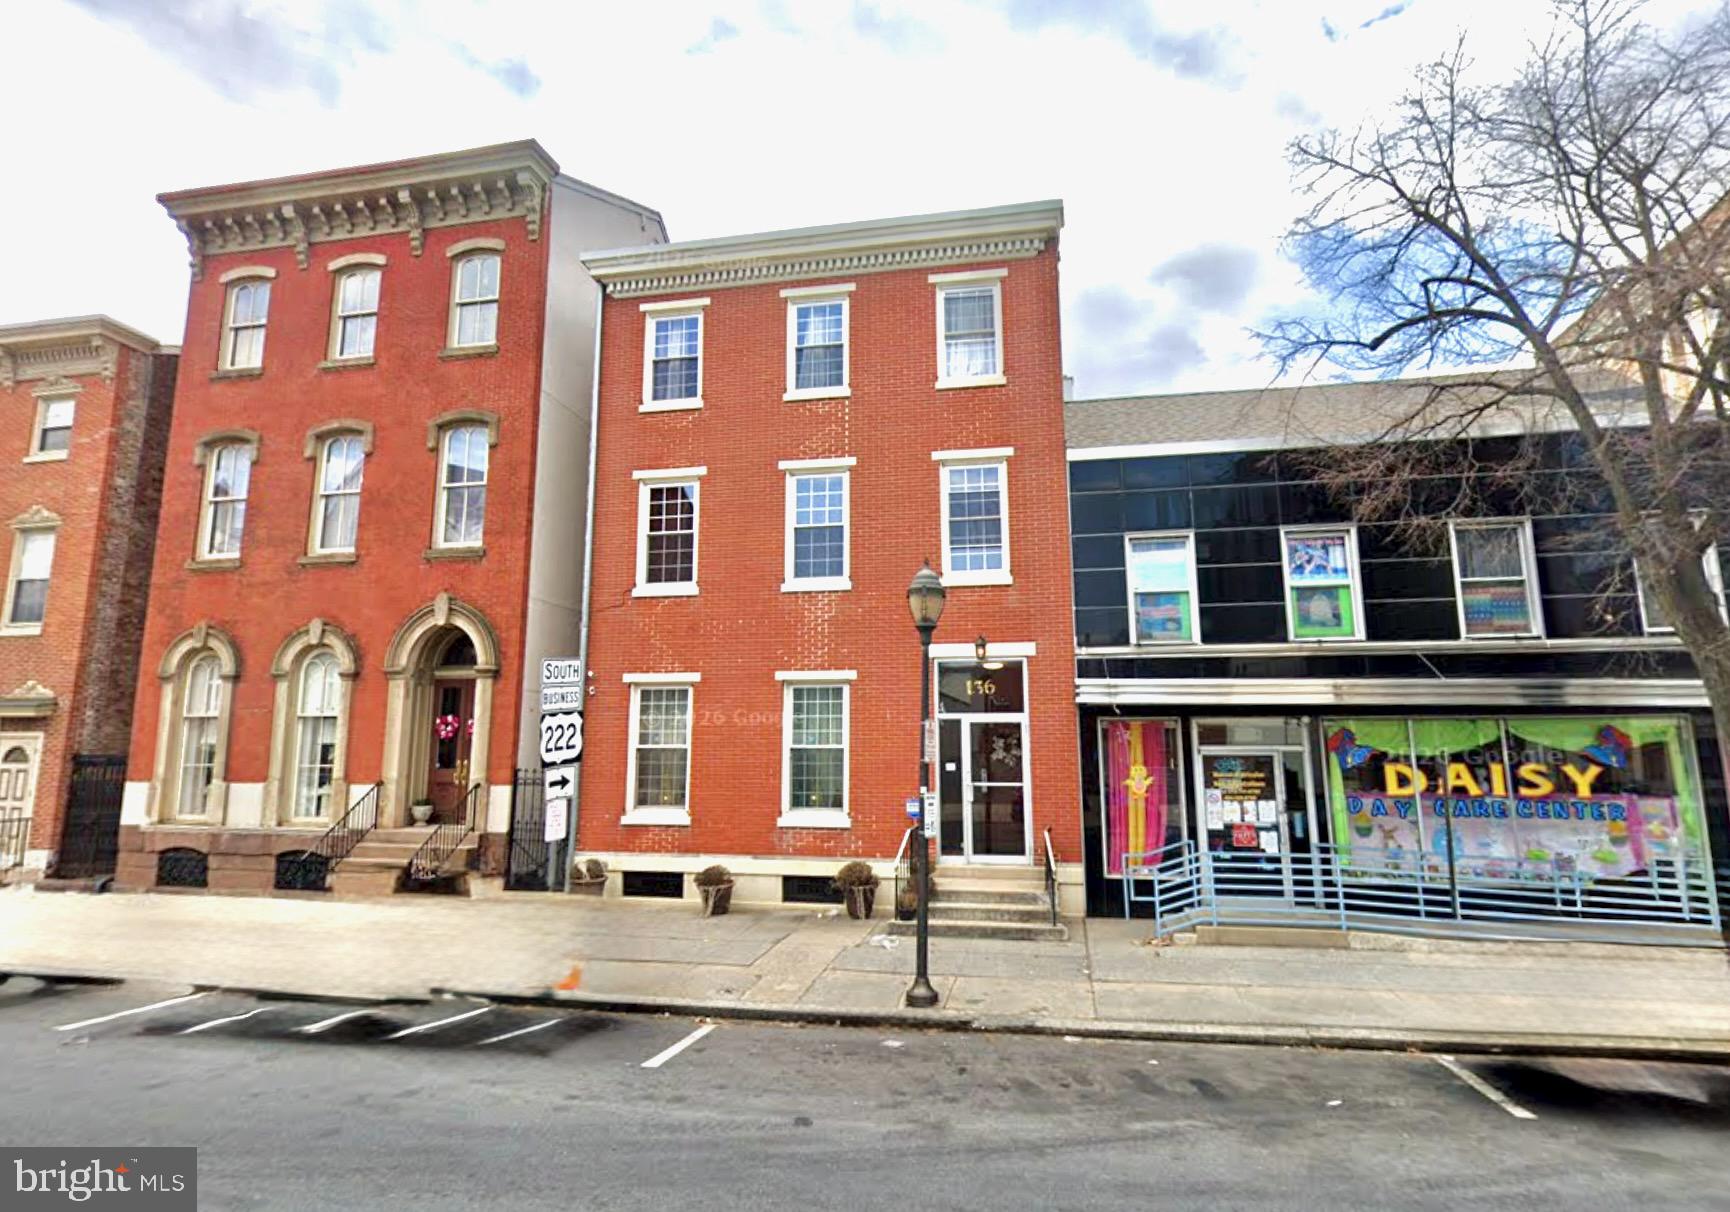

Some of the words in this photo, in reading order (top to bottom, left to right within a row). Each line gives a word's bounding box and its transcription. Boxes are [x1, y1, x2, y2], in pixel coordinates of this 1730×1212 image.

[544, 662, 580, 680] SOUTH
[543, 690, 580, 705] BUSINESS
[965, 679, 996, 696] 136
[545, 722, 577, 753] 222
[1383, 761, 1605, 799] DAISY
[1347, 796, 1412, 819] DAY
[1433, 797, 1509, 819] CARE
[1515, 799, 1628, 821] CENTER
